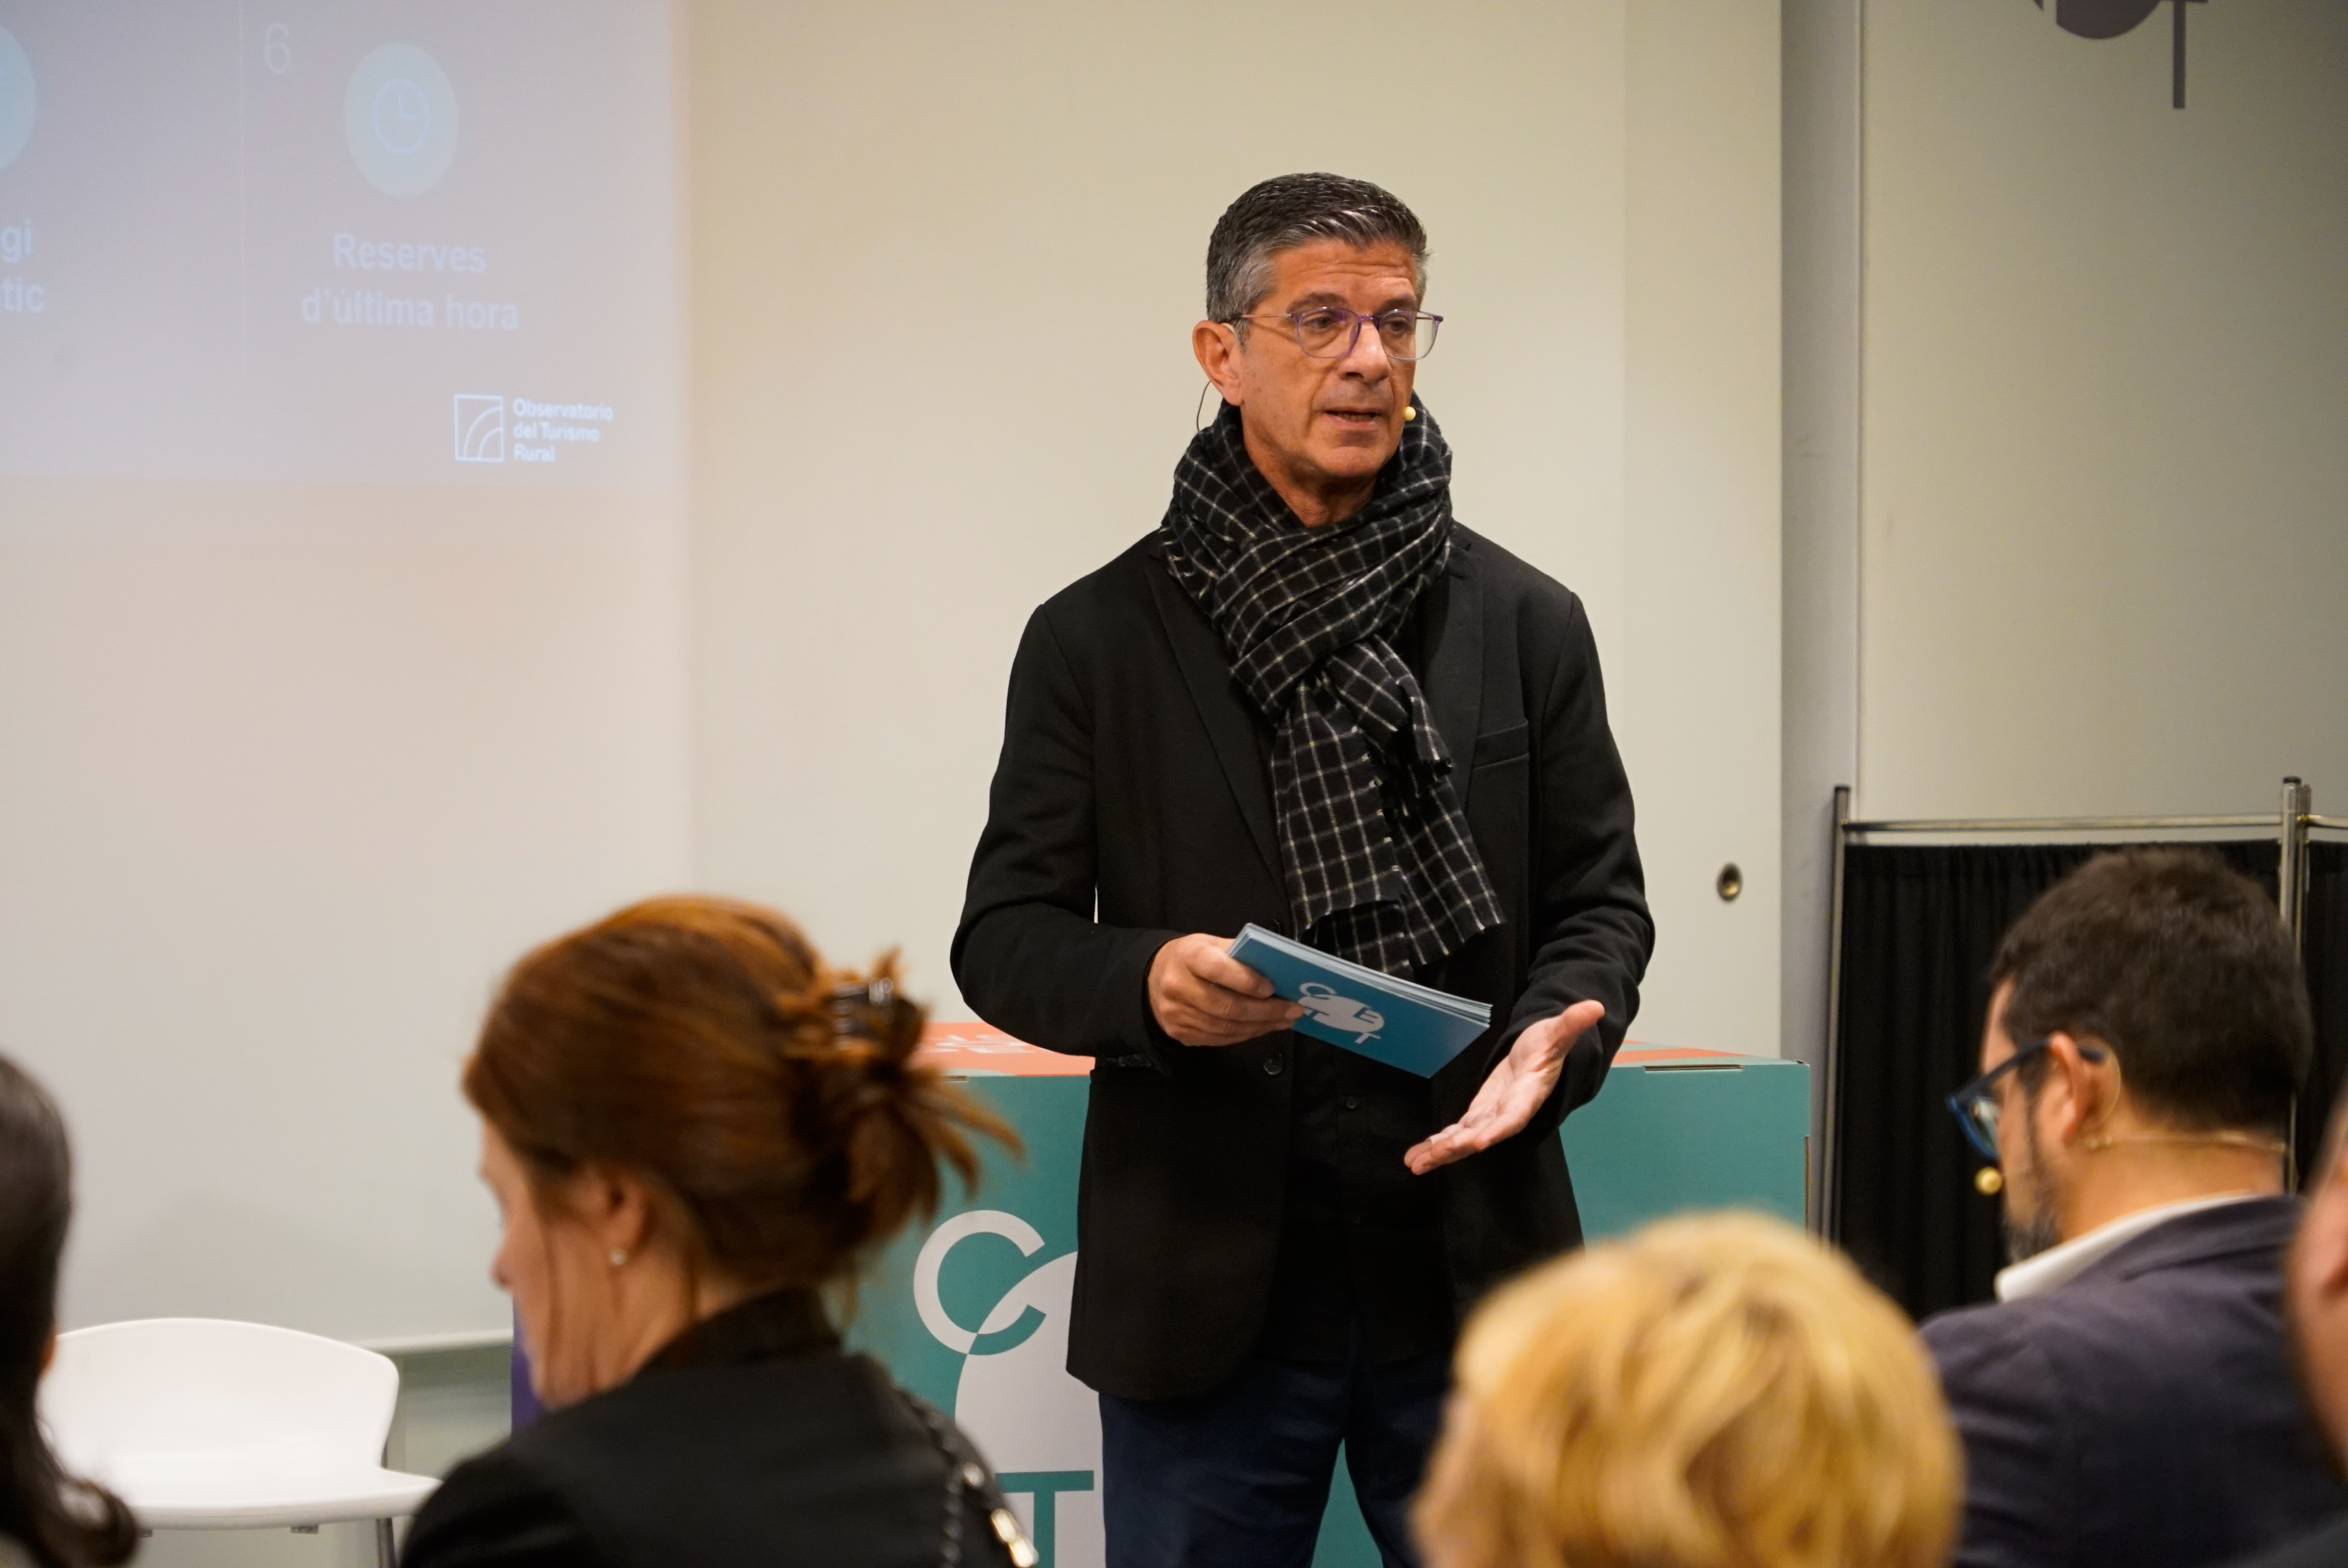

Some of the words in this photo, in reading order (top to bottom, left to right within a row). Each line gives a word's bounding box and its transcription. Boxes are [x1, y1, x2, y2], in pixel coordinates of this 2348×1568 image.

[263, 23, 290, 74] 6
[334, 232, 486, 274] Reserves
[445, 291, 519, 330] hora
[513, 398, 614, 420] Observatorio
[514, 422, 536, 439] del
[539, 422, 600, 442] Turismo
[514, 443, 555, 462] Rural
